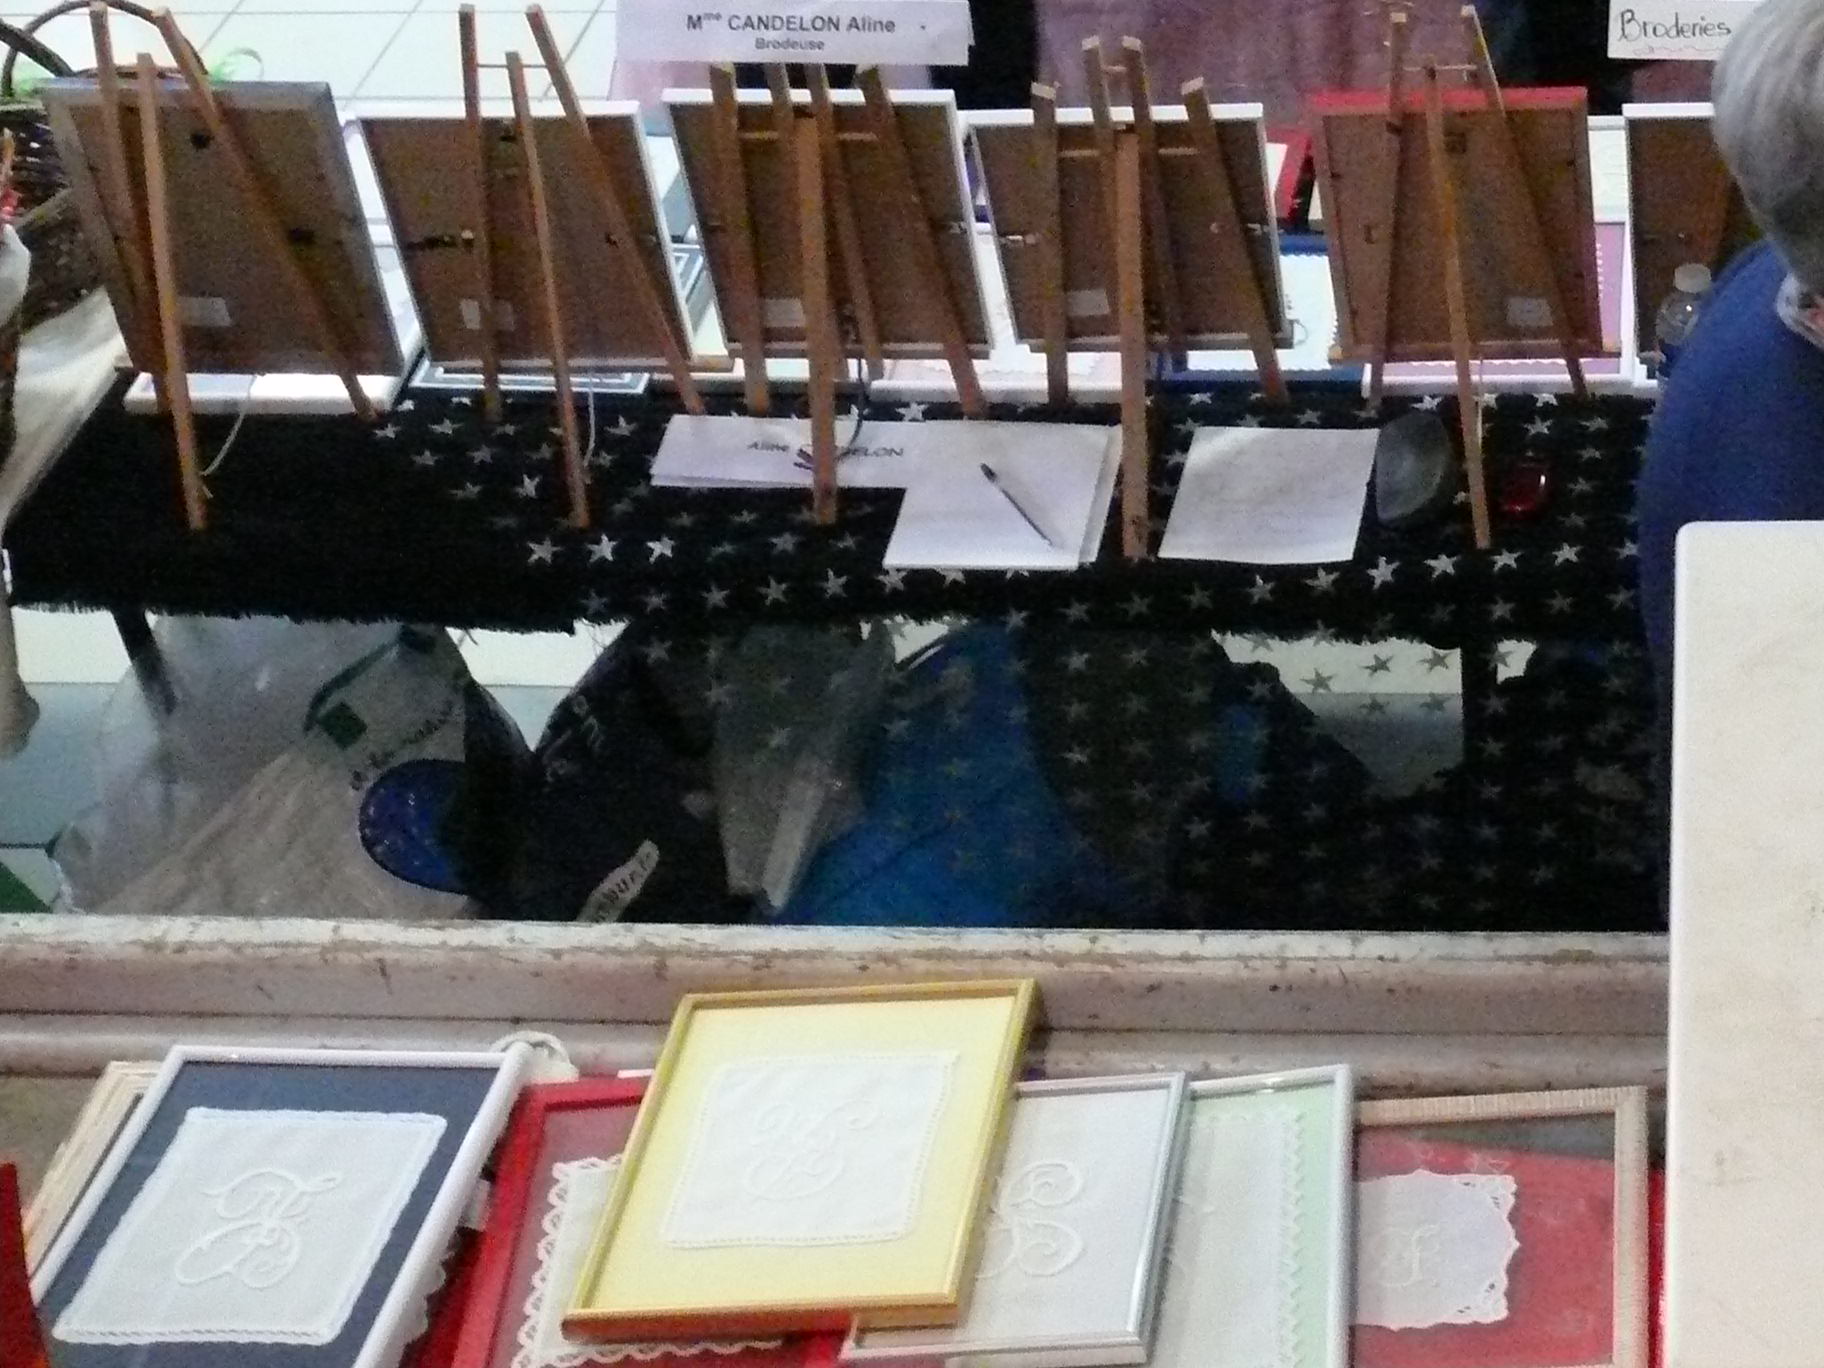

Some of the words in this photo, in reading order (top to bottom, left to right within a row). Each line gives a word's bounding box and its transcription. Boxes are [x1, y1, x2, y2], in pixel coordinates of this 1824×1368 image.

[727, 14, 841, 32] CANDELON
[846, 15, 897, 33] Aline
[1618, 8, 1733, 43] Broderies
[754, 37, 826, 51] Brodeuse
